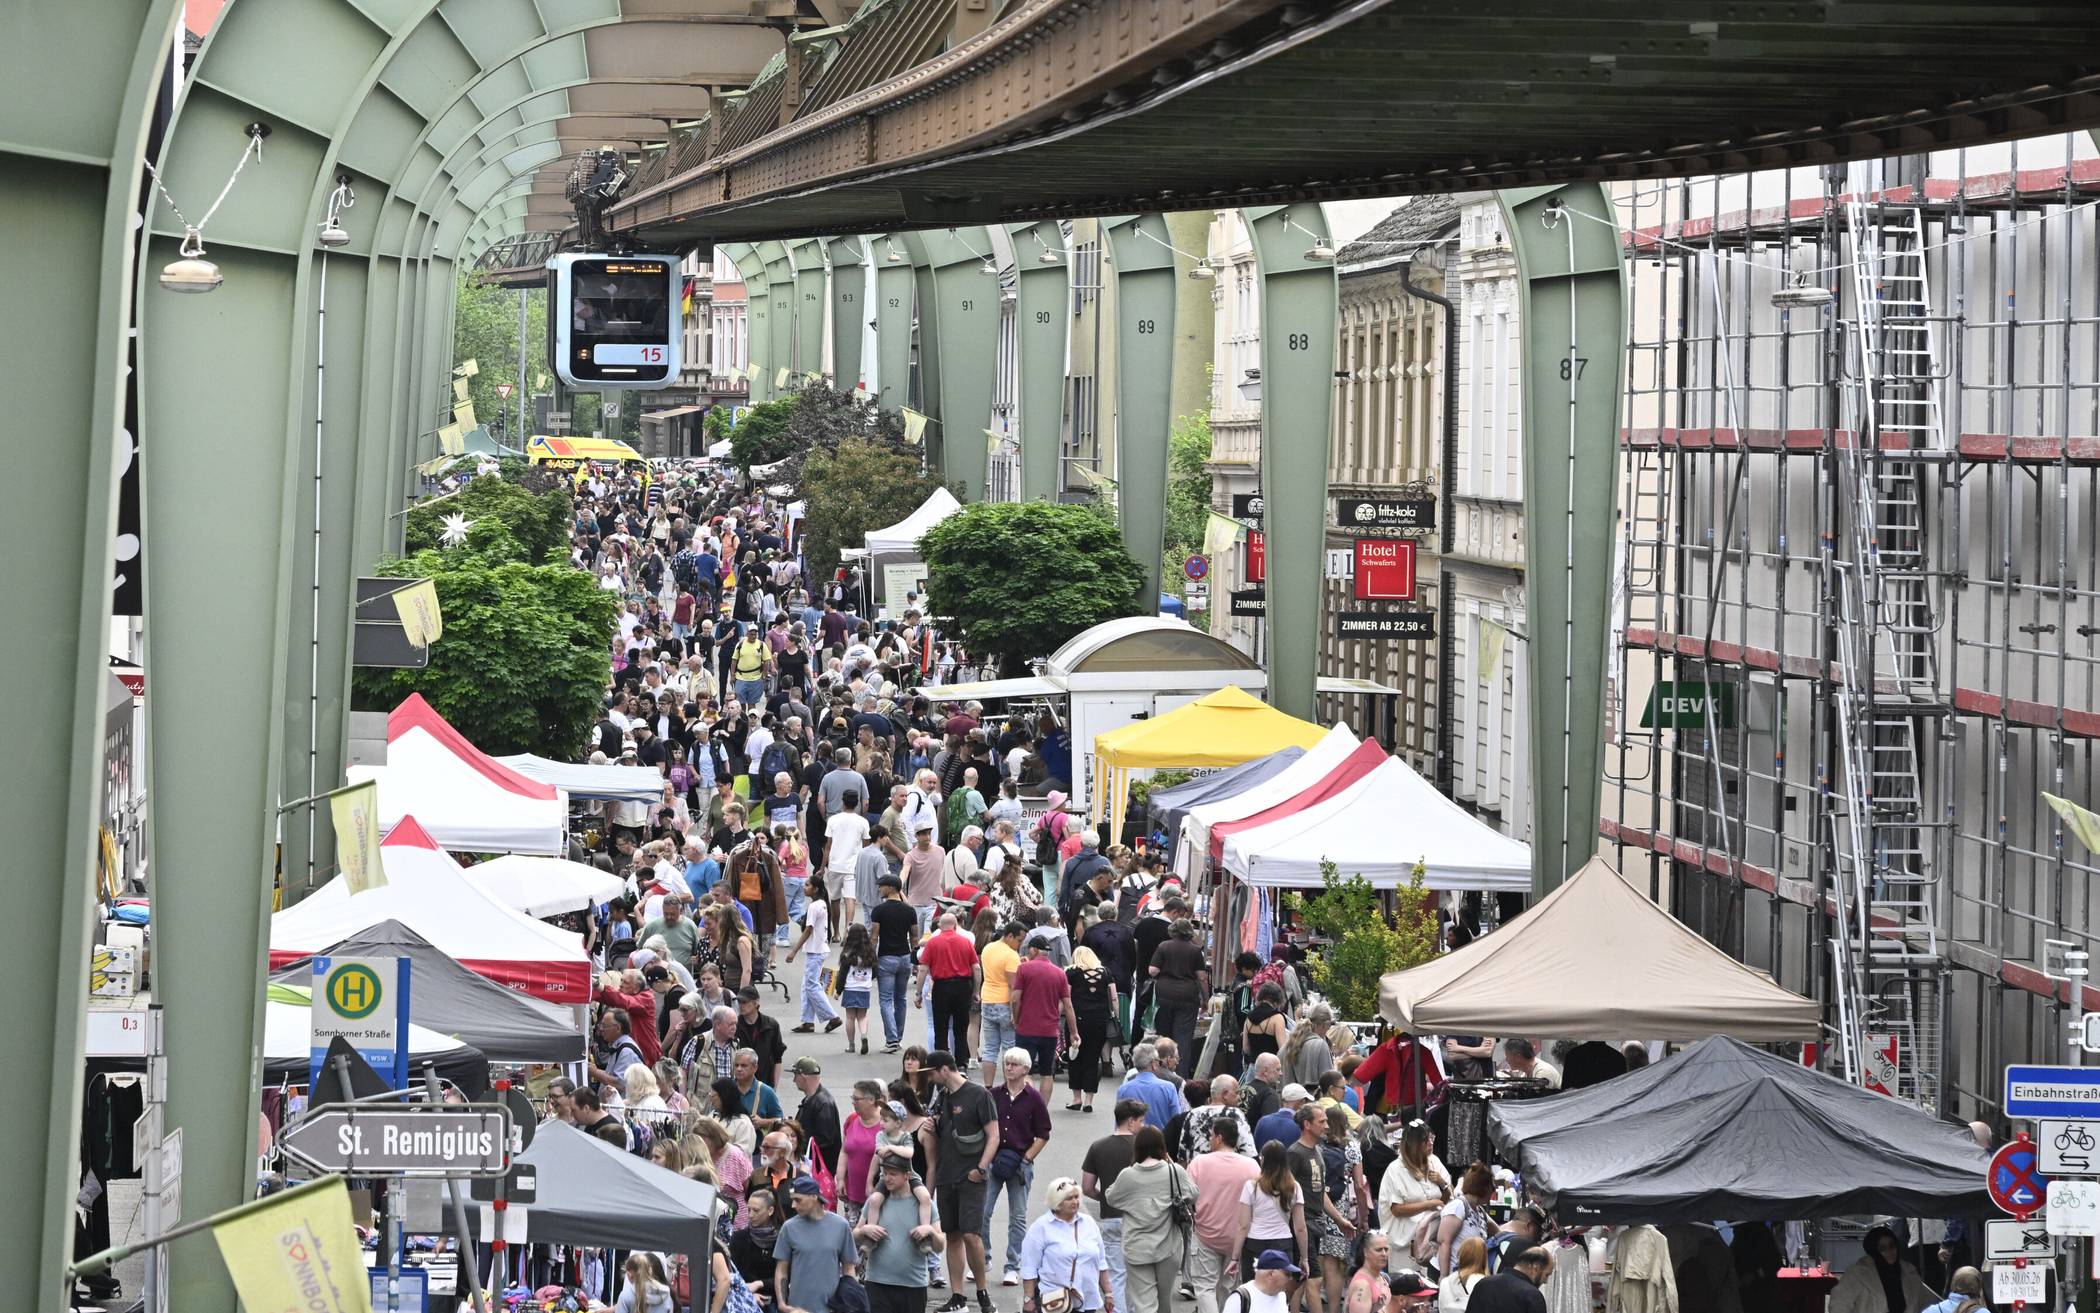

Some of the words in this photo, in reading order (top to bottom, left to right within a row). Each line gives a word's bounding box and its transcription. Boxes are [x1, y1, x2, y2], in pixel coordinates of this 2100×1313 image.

[842, 294, 853, 302] 93
[888, 299, 899, 308] 92
[962, 300, 973, 311] 91
[1036, 312, 1050, 323] 90
[1138, 320, 1154, 334] 89
[1289, 333, 1308, 350] 88
[641, 348, 661, 361] 15
[1560, 358, 1589, 381] 87
[553, 459, 576, 469] ASB
[1378, 504, 1416, 517] fritz-kola
[1361, 544, 1396, 556] Hotel
[1361, 559, 1397, 567] Schwaferts
[1235, 600, 1266, 609] ZIMMER
[1342, 621, 1377, 631] ZIMMER
[1380, 621, 1392, 631] AB
[1394, 621, 1418, 632] 22,50
[318, 961, 324, 969] 3
[508, 981, 526, 989] SPD
[546, 983, 564, 991] SPD
[342, 976, 365, 1007] H
[314, 1029, 362, 1039] Sonnborner
[364, 1030, 391, 1039] Straße
[2015, 1086, 2100, 1099] Einbahnstraß
[338, 1124, 370, 1156] St.
[383, 1124, 492, 1160] Remigius
[1999, 1272, 2009, 1285] Ab
